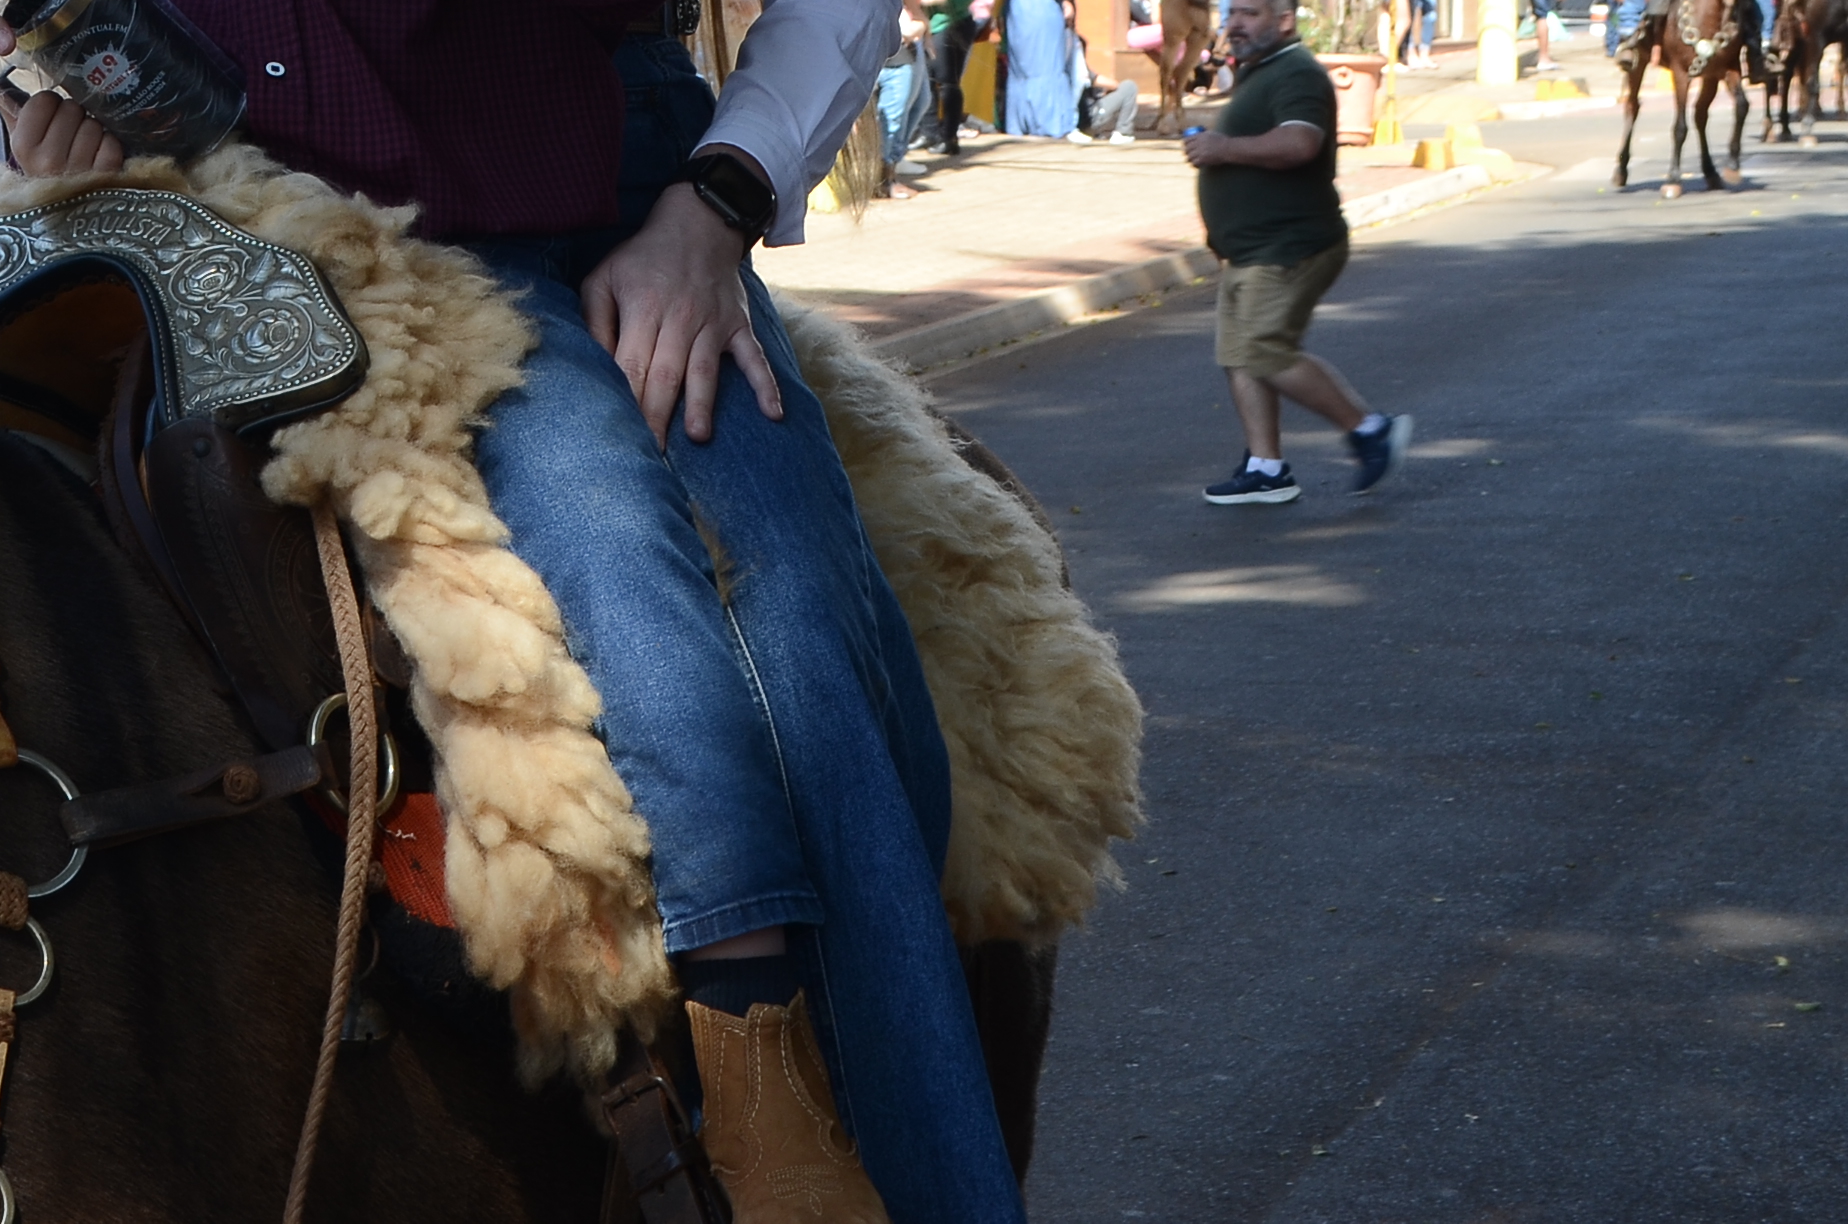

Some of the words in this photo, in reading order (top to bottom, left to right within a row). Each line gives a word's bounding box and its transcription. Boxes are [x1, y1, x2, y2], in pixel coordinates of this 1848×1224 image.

[71, 23, 114, 43] PONTUAL
[115, 23, 129, 34] FM
[86, 54, 118, 86] 87.9
[72, 215, 172, 246] PAULISTA
